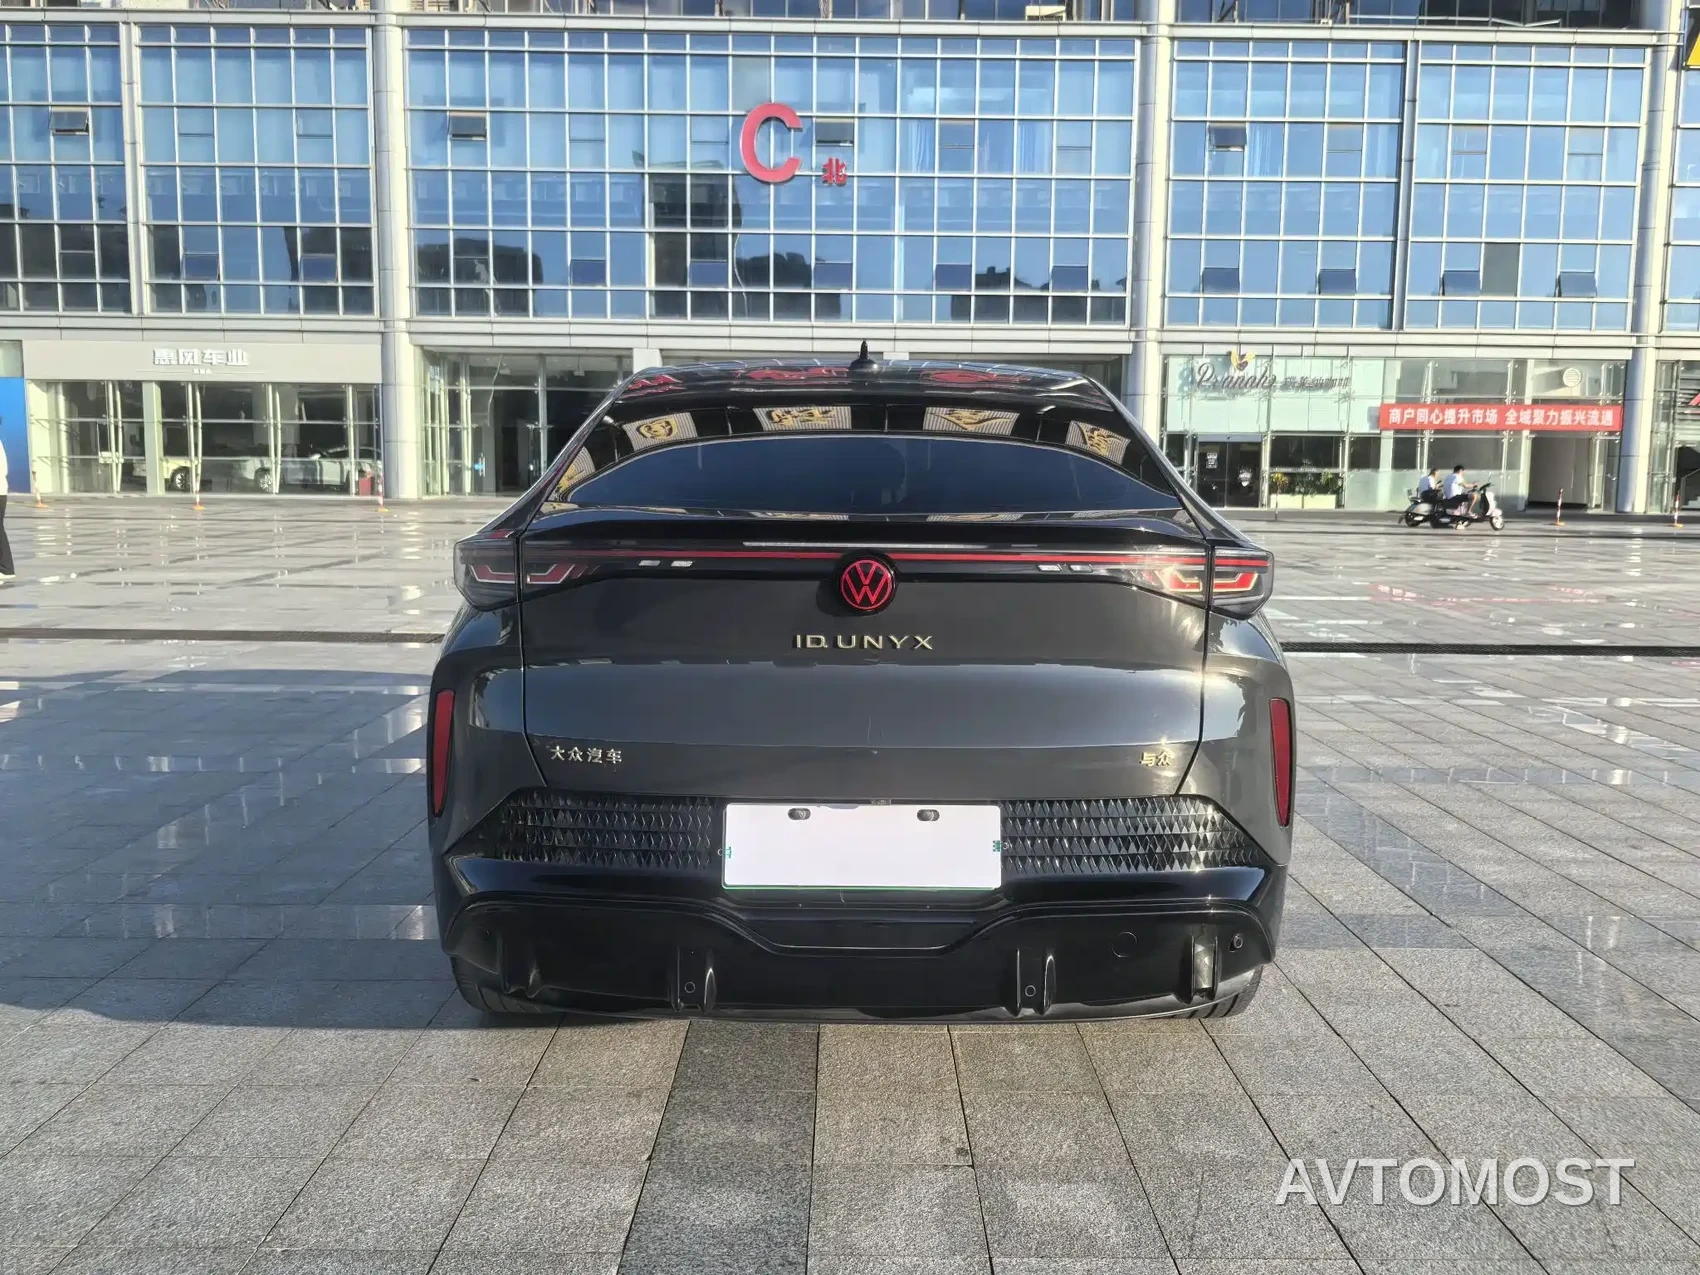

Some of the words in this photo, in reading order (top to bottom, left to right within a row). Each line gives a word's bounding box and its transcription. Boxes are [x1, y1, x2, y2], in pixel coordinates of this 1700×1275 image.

[740, 103, 803, 184] C
[822, 158, 848, 186] 北
[153, 348, 250, 366] 惠风车业
[1388, 407, 1499, 426] 商户同心提升市场
[841, 559, 893, 610] VW
[837, 634, 934, 650] UNYX
[550, 745, 622, 764] 大众汽车
[1141, 751, 1172, 767] 与众
